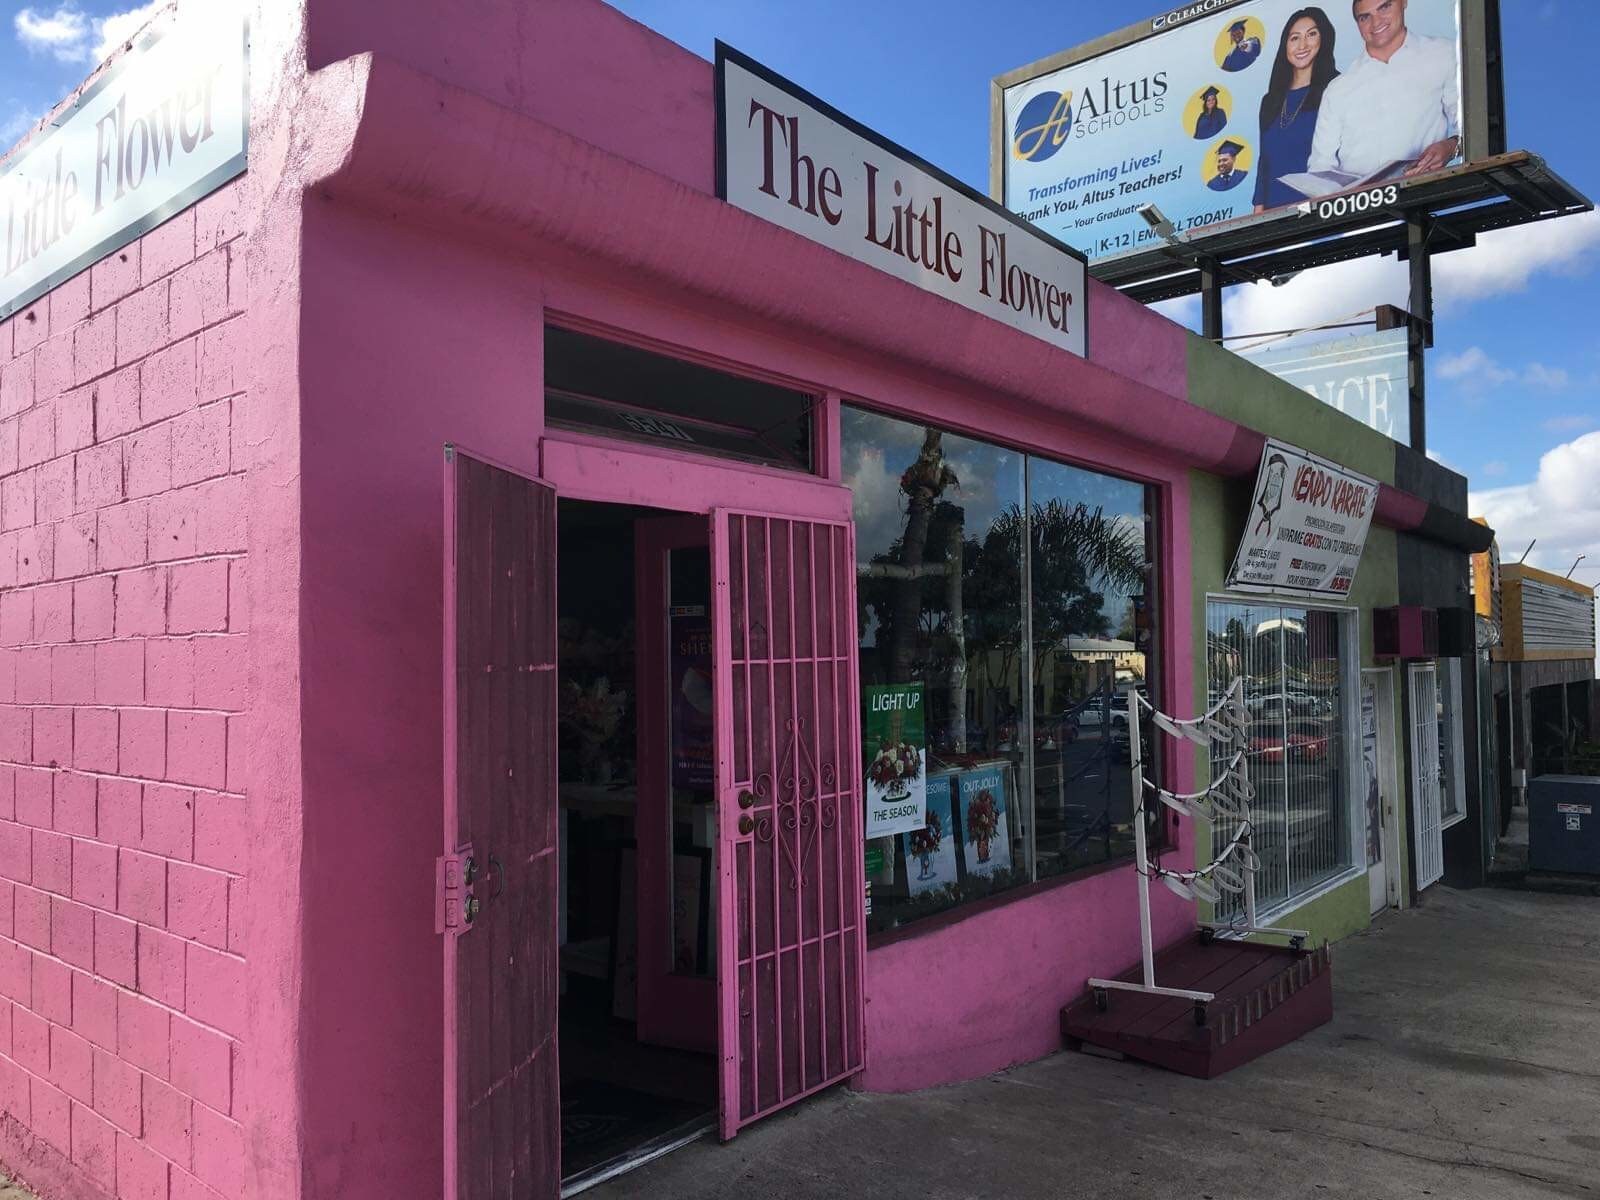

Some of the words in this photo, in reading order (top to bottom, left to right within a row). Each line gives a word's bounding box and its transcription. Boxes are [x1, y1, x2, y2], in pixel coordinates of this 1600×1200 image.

[1073, 71, 1168, 124] Altus
[1075, 98, 1165, 139] SCHOOLS
[2, 145, 79, 279] Little
[91, 64, 223, 216] Flower
[1028, 167, 1118, 202] Transforming
[1121, 150, 1162, 175] Lives!
[1016, 204, 1051, 223] hank
[1054, 200, 1079, 214] You,
[1082, 188, 1115, 206] Altus
[1119, 165, 1183, 196] Teachers!
[1319, 185, 1397, 219] 001093
[748, 97, 843, 226] The
[863, 161, 963, 283] Little
[978, 224, 1073, 335] Flower
[1074, 217, 1095, 229] Your
[1100, 234, 1130, 252] K-12
[1186, 207, 1233, 229] TODAY!
[1331, 479, 1369, 519] KARATE
[872, 693, 904, 711] LIGHT
[906, 692, 920, 709] UP
[873, 809, 887, 822] THE
[889, 804, 918, 819] SEASON
